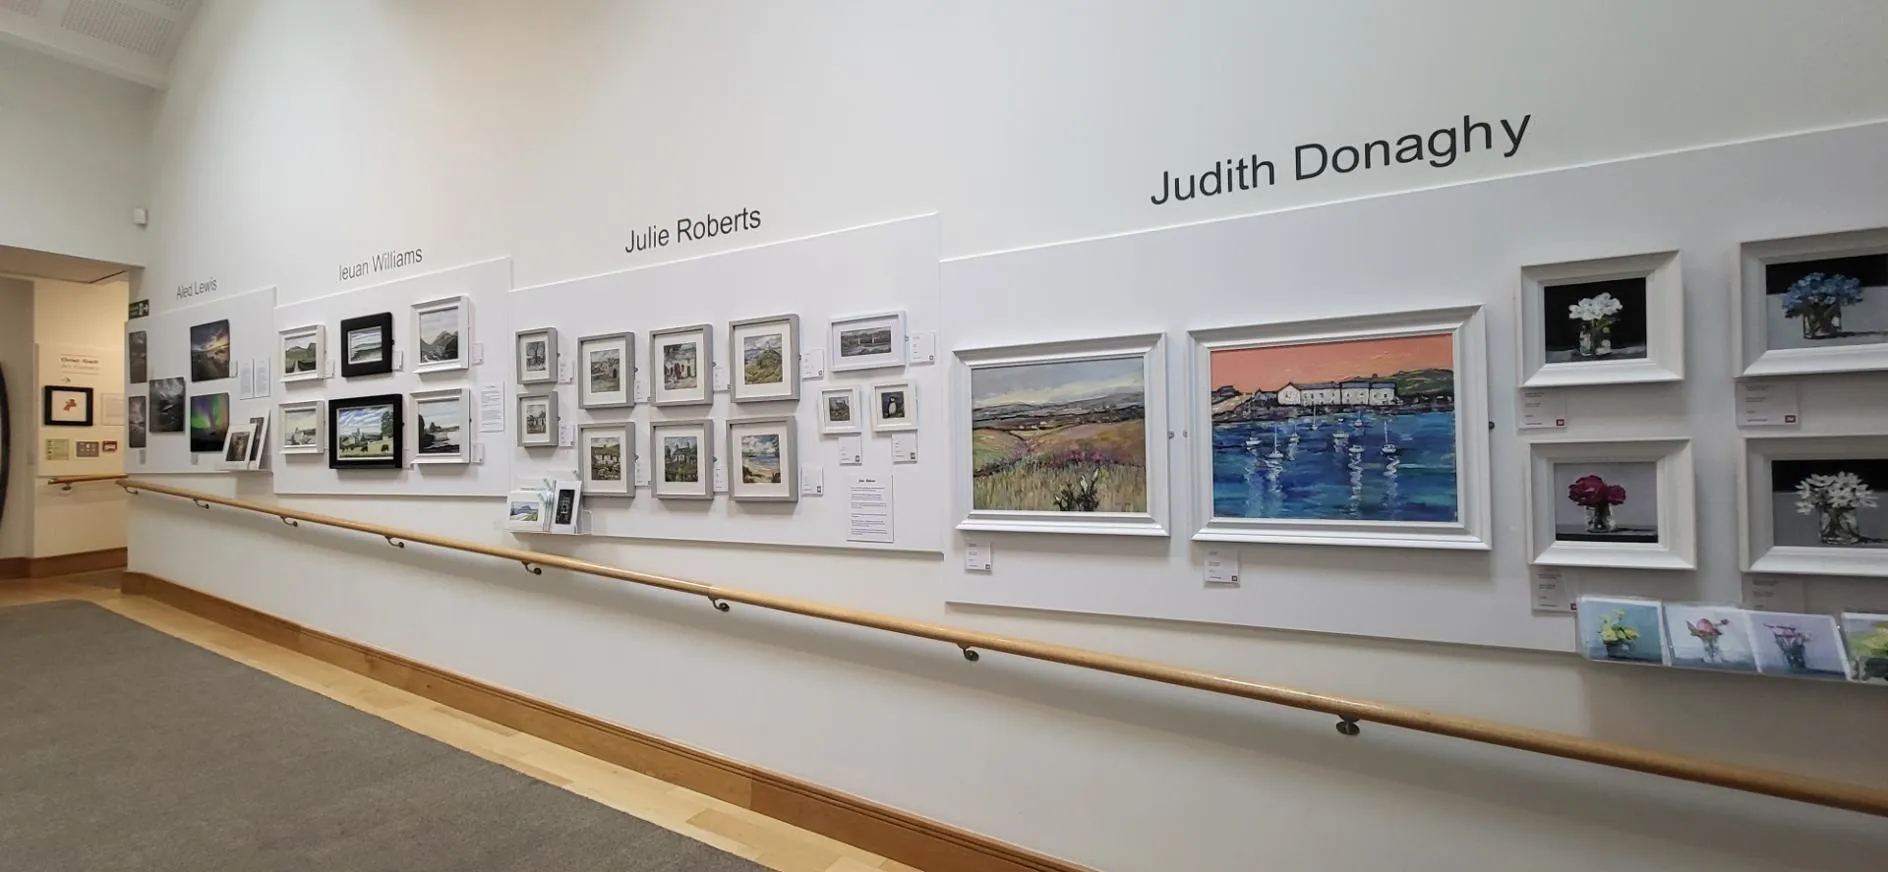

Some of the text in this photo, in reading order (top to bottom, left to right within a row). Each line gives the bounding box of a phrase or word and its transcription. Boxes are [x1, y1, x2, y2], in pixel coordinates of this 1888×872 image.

[1150, 114, 1531, 205] Judith Donaghy
[625, 207, 761, 253] Julie Roberts
[338, 248, 423, 281] Ieuan Williams
[194, 277, 217, 295] Lewis
